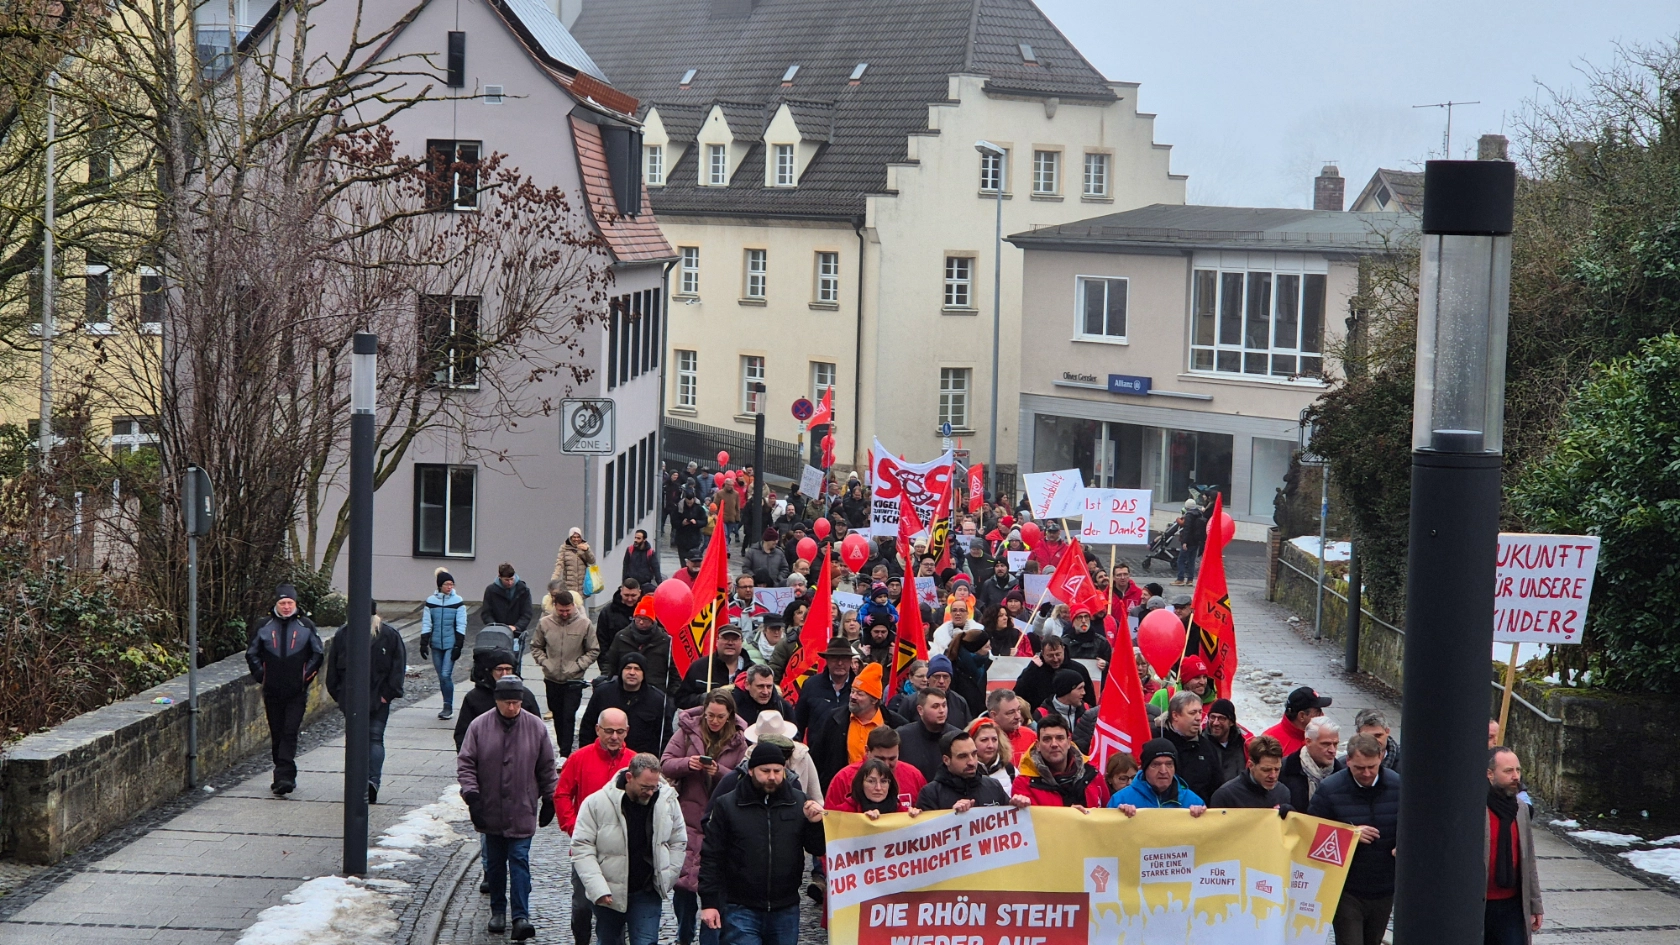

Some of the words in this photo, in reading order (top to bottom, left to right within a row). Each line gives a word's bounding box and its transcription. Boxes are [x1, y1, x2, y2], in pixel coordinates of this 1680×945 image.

[1063, 372, 1077, 380] Oliver
[1114, 379, 1133, 388] Allianz
[578, 413, 597, 429] 30
[575, 440, 600, 449] ZONE
[1085, 497, 1101, 510] Ist
[1112, 498, 1138, 512] DAS
[1083, 522, 1101, 536] der
[1109, 516, 1147, 538] Dank?
[1496, 543, 1593, 569] UKUNFT
[1495, 573, 1514, 598] ÜR
[1519, 577, 1587, 599] UNSERE
[1207, 601, 1228, 625] Vst.
[884, 824, 963, 859] ZUKUNFT
[969, 807, 1020, 837] NICHT
[864, 843, 972, 885] GESCHICHTE
[978, 830, 1029, 856] WIRD.
[1143, 852, 1188, 861] GEMEINSAM
[1150, 860, 1164, 868] FÜR
[1141, 868, 1169, 877] STARKE
[1170, 867, 1192, 875] RHÖN
[1210, 867, 1225, 876] FÜR
[1199, 878, 1236, 886] ZUKUNFT
[869, 903, 908, 927] DIE
[917, 895, 986, 926] RHÖN
[996, 903, 1080, 928] STEHT
